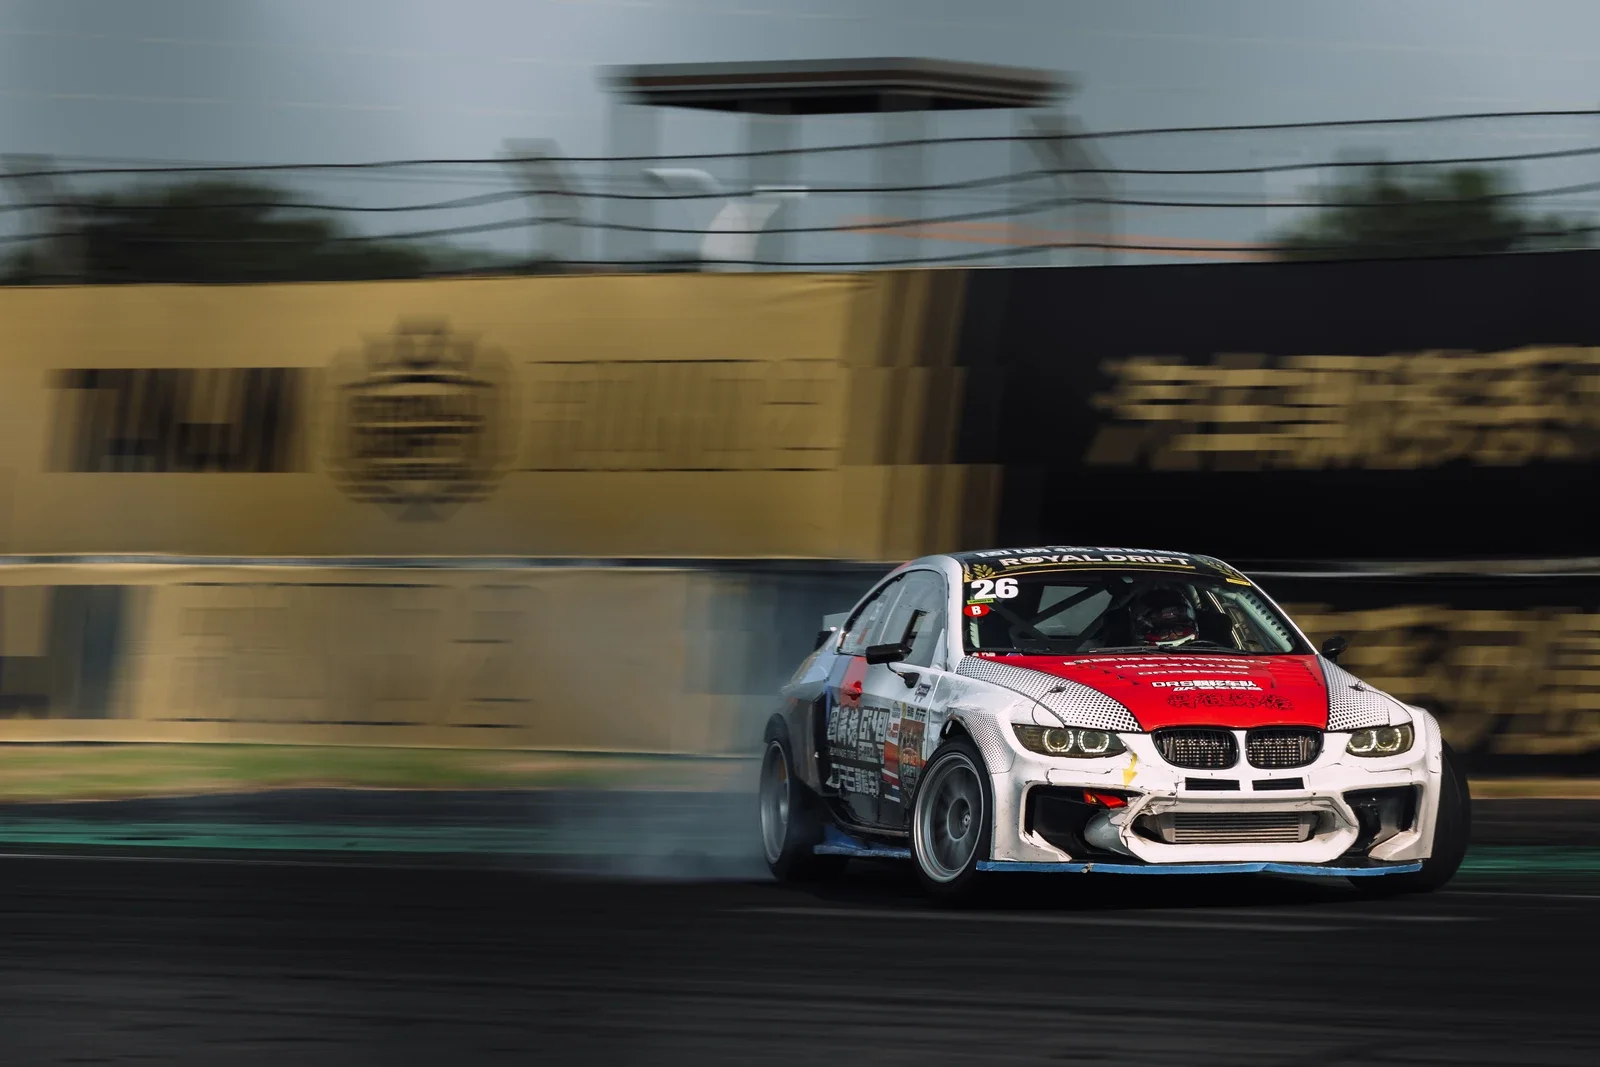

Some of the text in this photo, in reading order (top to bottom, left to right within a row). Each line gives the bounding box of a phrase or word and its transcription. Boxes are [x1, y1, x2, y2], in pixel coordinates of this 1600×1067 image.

[999, 554, 1189, 566] ROYAL DRIFT
[970, 578, 1019, 600] 26
[971, 605, 982, 616] B
